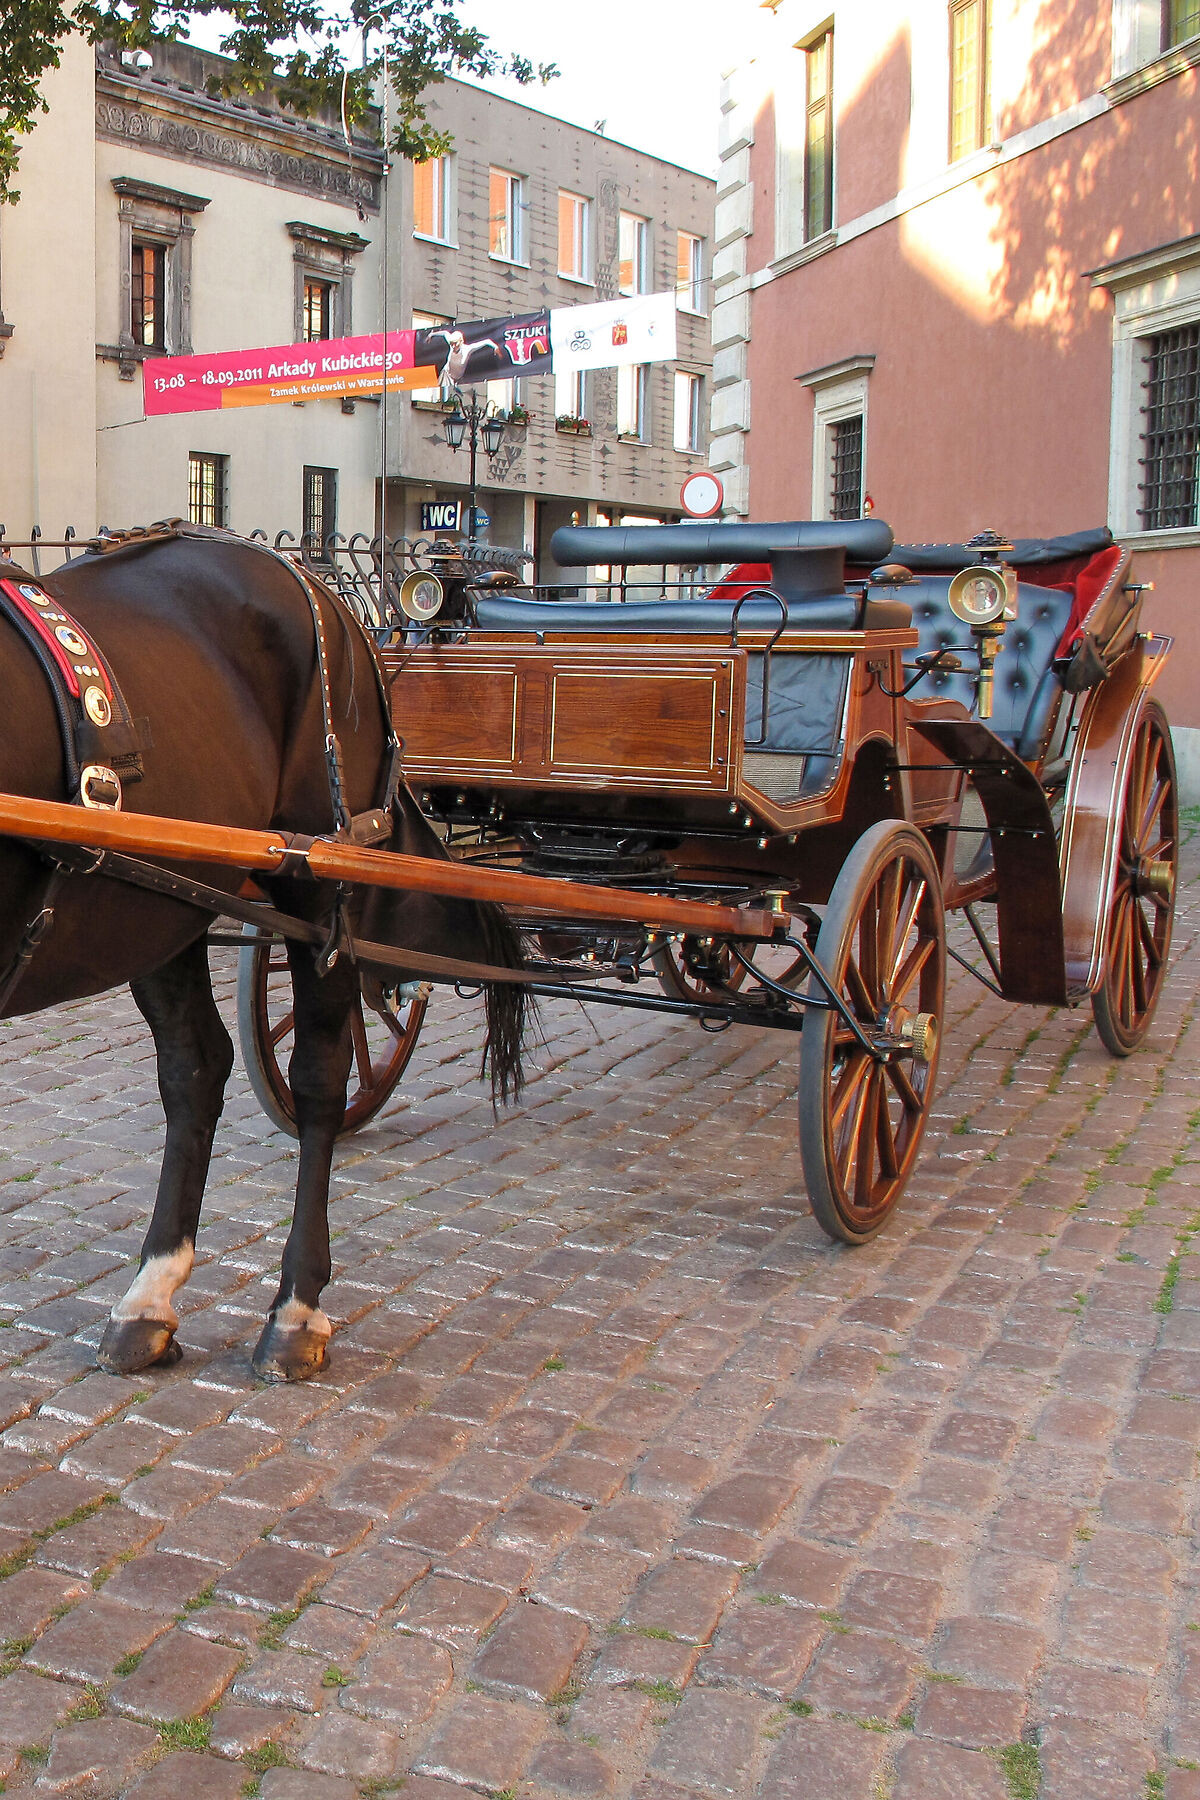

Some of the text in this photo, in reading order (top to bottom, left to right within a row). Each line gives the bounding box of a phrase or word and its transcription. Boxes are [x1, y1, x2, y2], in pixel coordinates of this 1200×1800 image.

[504, 326, 547, 341] SZTUKI
[153, 373, 186, 393] 13.08
[201, 367, 263, 386] 18.09.2011
[267, 359, 317, 378] Arkady
[322, 352, 403, 373] Kubickiego
[269, 386, 299, 397] Zamek
[301, 380, 346, 394] Królewski
[428, 505, 456, 527] WC
[476, 517, 490, 526] WC
